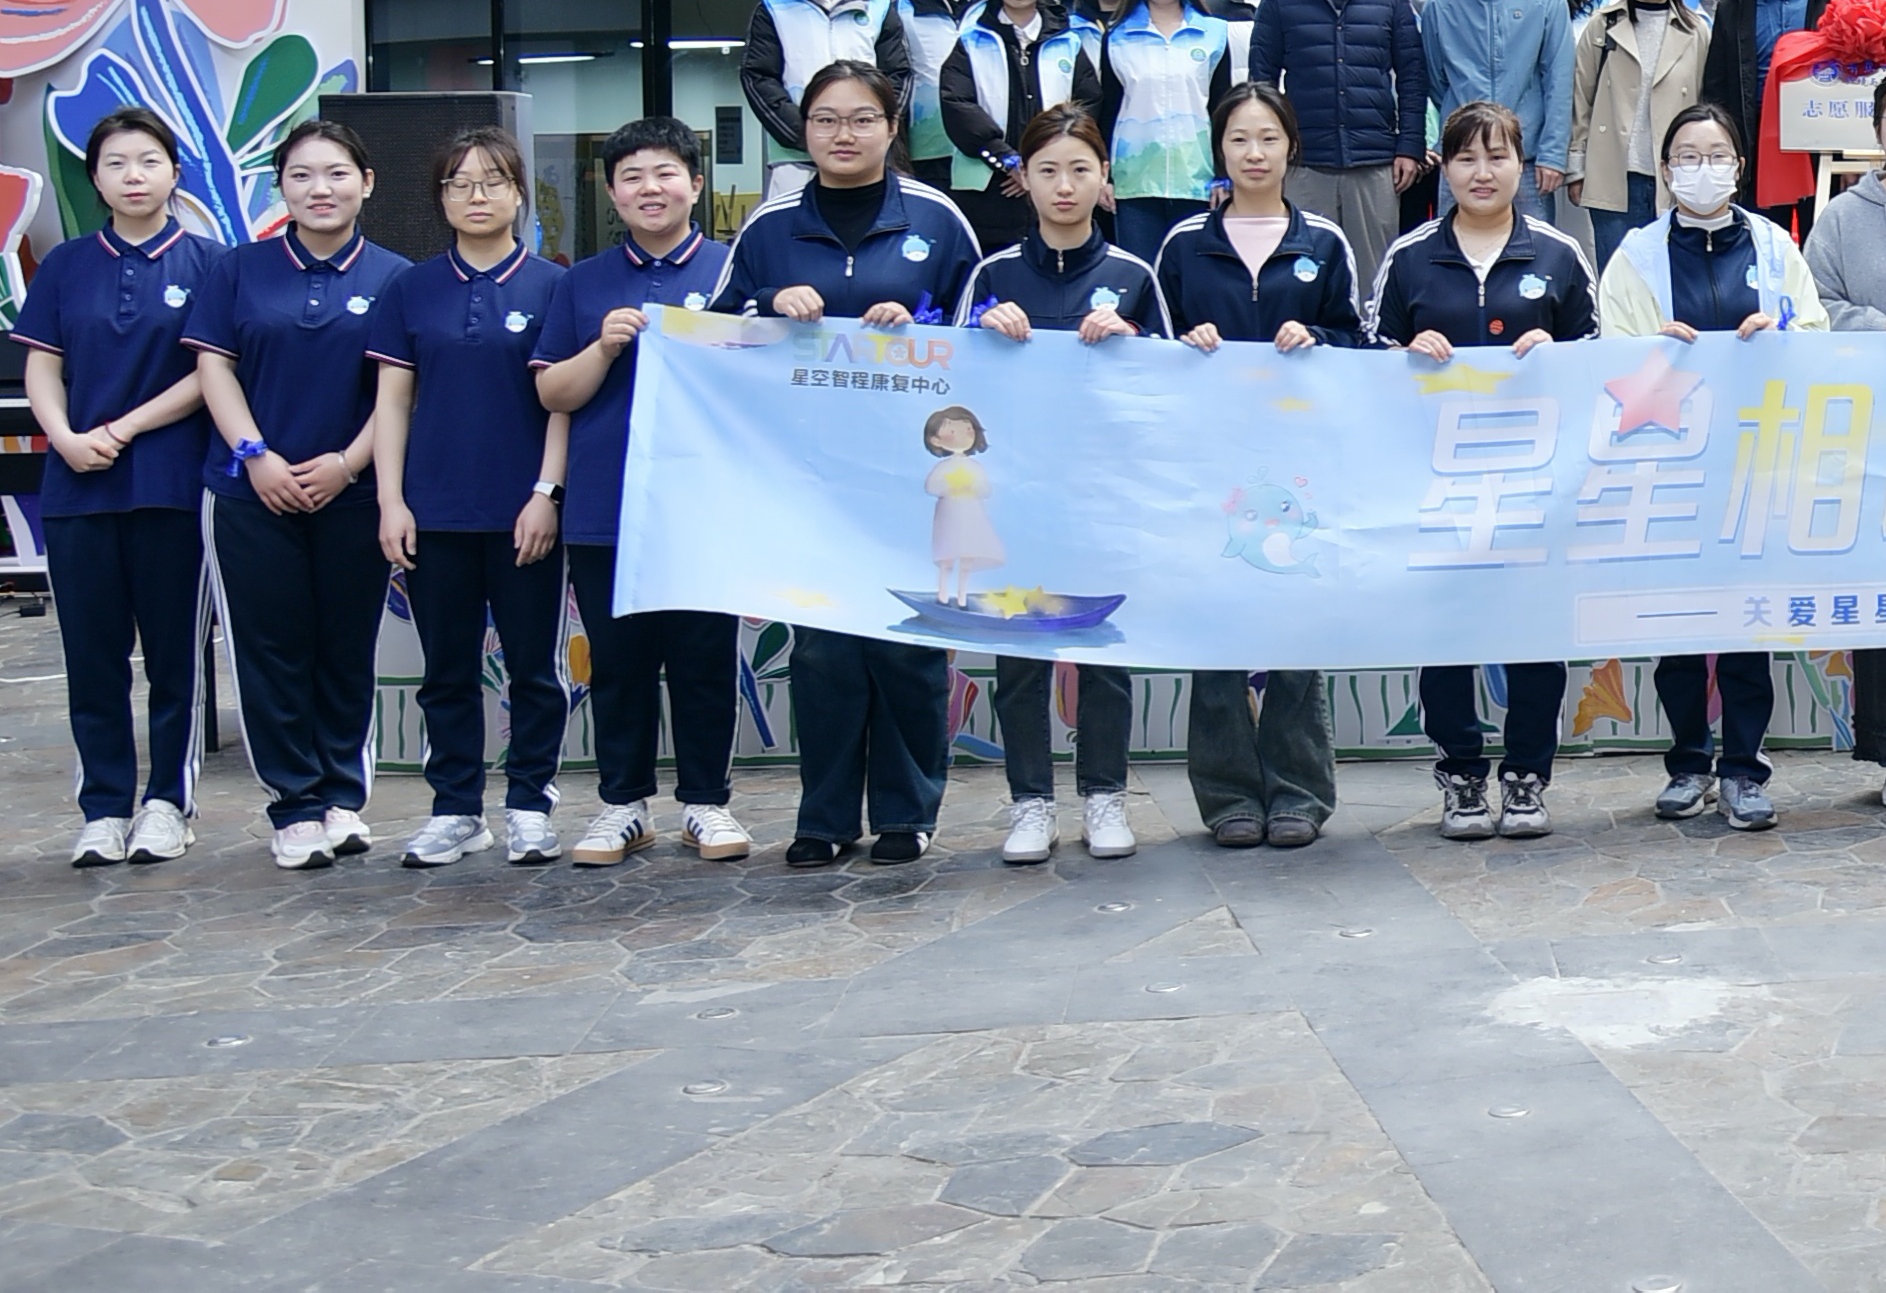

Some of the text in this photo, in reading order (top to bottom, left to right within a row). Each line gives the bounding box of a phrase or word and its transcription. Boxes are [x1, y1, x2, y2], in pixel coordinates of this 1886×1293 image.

[792, 330, 955, 371] STARTOUR
[790, 368, 951, 396] 星空智程康复中心
